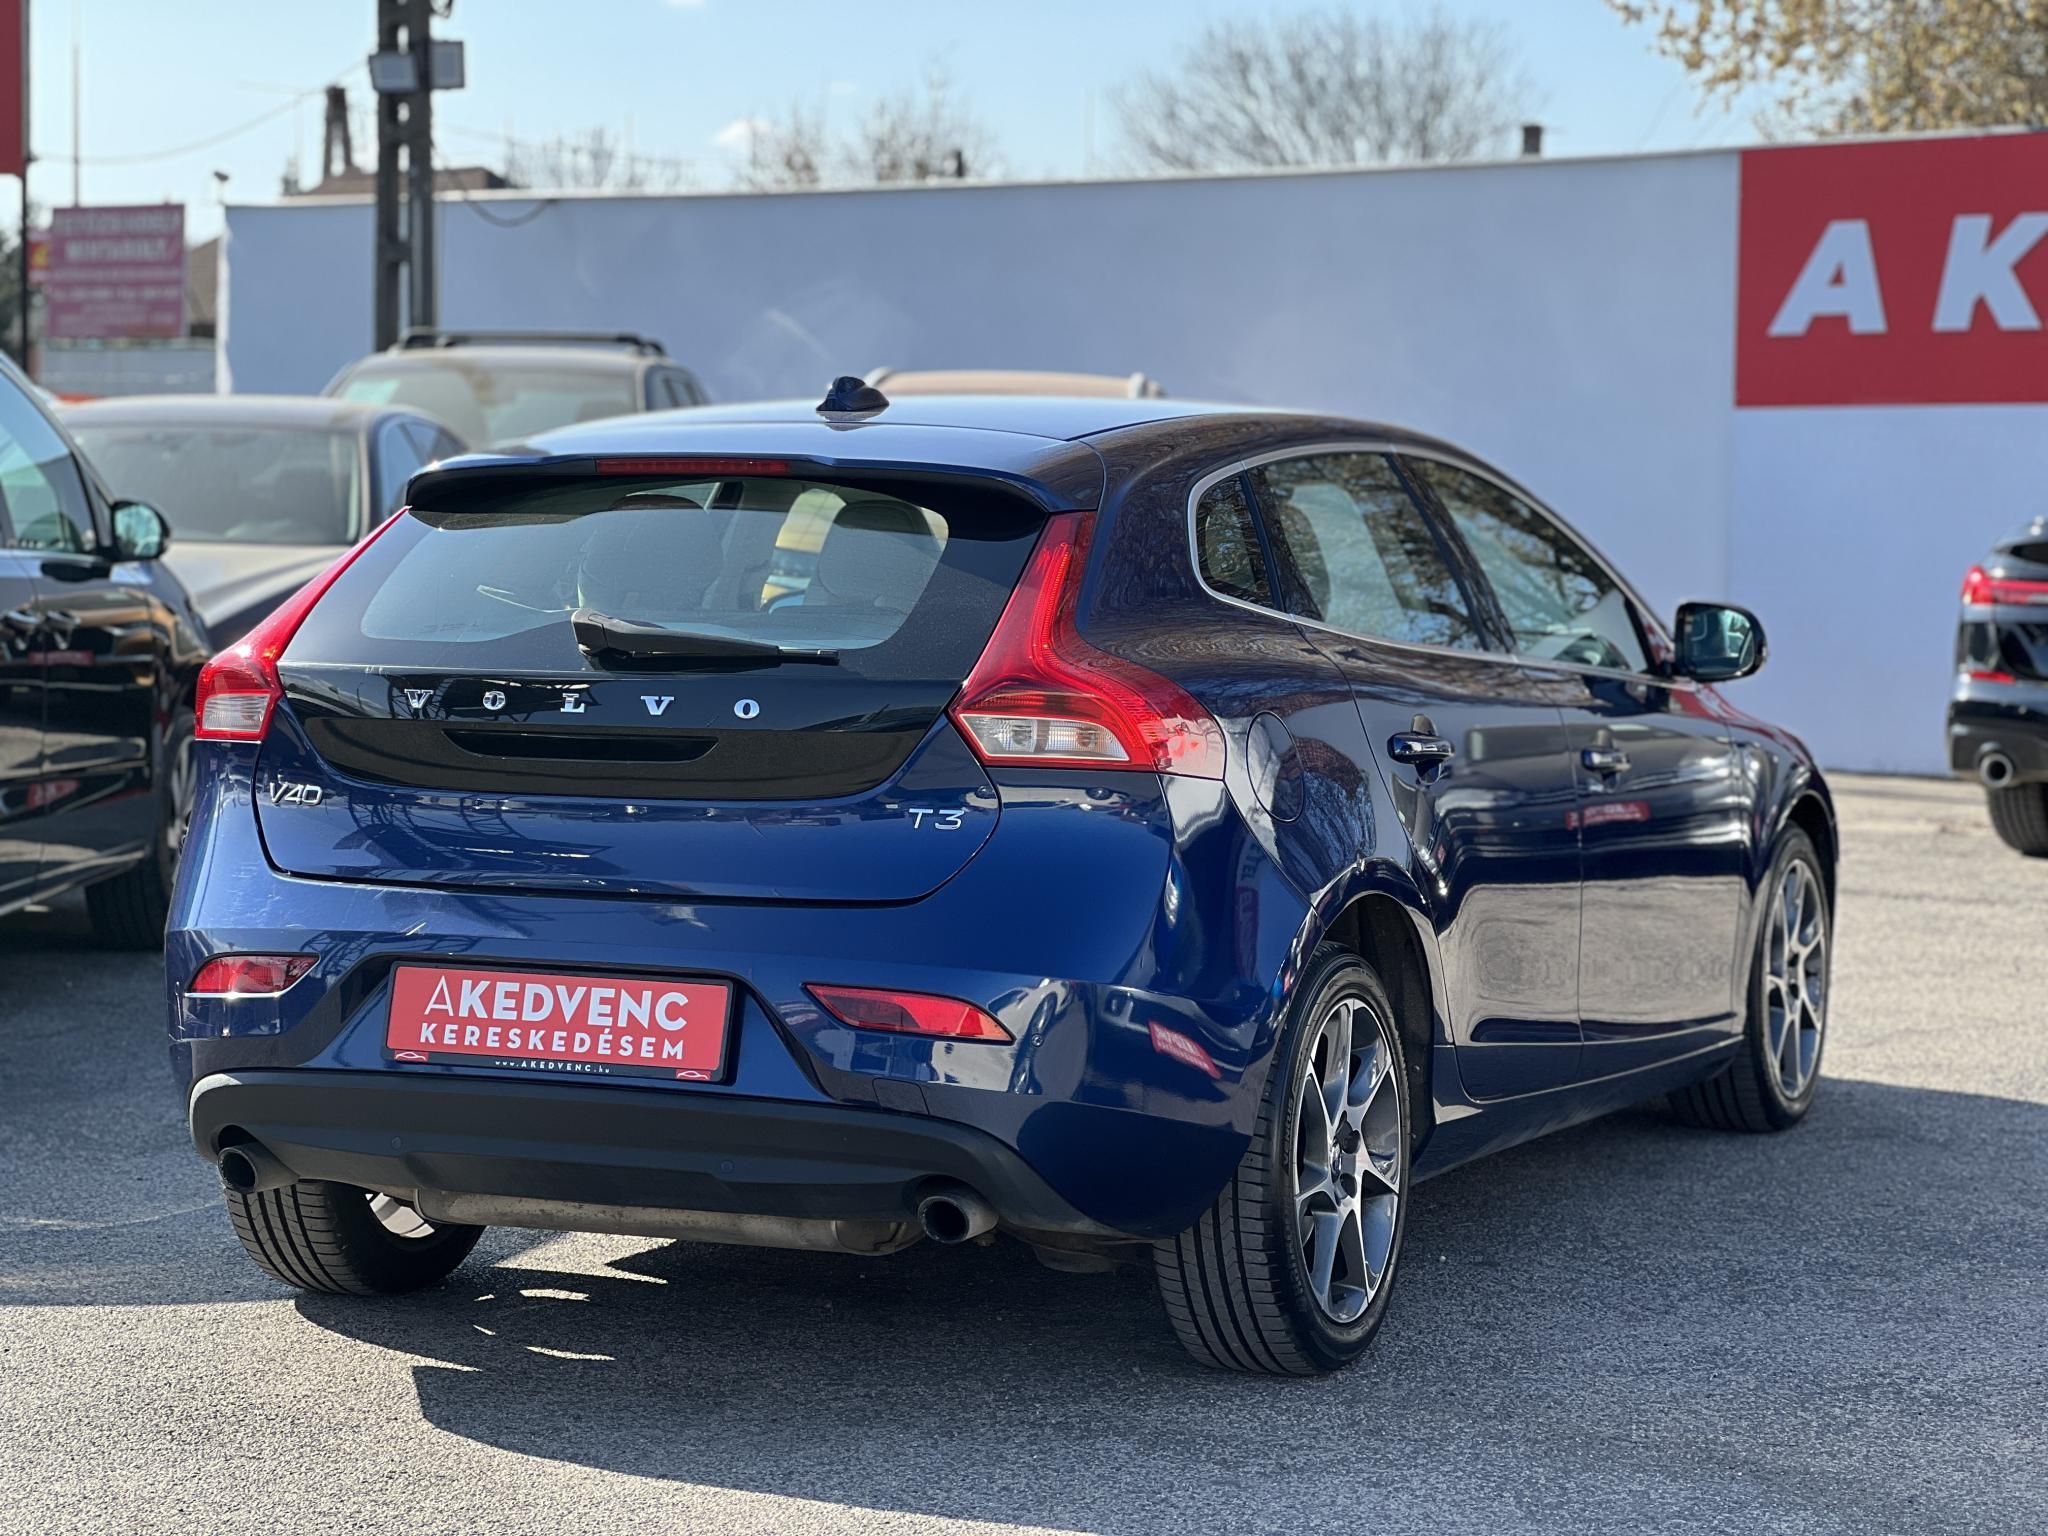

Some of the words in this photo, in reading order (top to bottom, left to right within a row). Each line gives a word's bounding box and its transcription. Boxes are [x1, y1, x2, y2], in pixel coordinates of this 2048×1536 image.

[404, 688, 760, 719] VOLVO
[269, 782, 322, 806] V40
[908, 808, 965, 830] T3
[423, 975, 689, 1032] AKEDVENC
[419, 1022, 685, 1061] KERESKEDÉSEM
